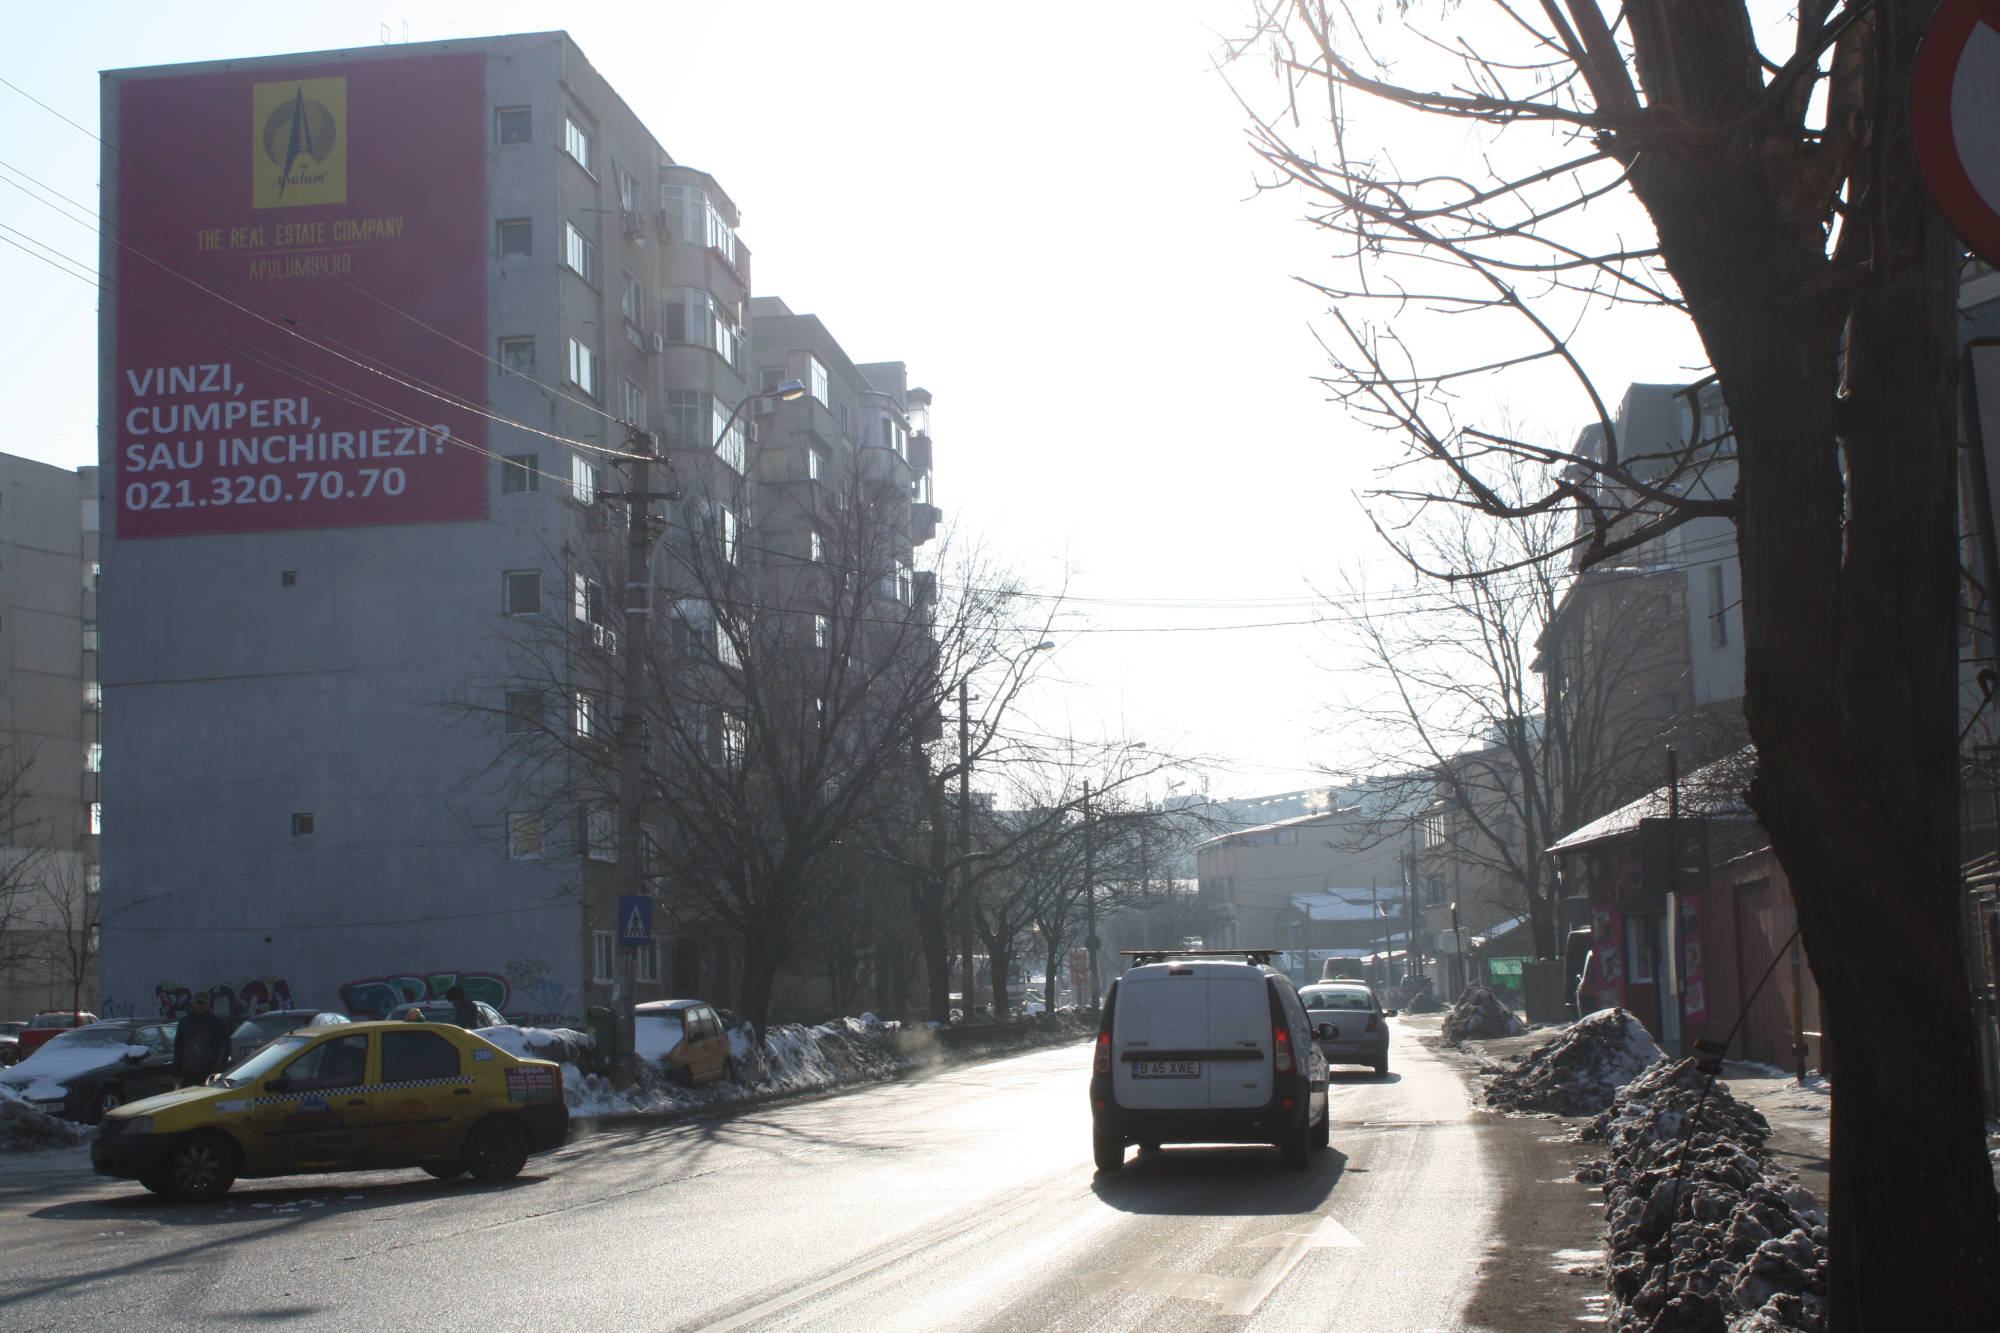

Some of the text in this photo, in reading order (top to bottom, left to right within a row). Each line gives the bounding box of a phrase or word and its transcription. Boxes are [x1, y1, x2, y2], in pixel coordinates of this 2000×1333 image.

[197, 216, 404, 251] THE REAL ESTATE COMPANY
[126, 363, 245, 397] VINZI,
[125, 397, 322, 435] CUMPERI,
[125, 424, 450, 473] SAU INCHIRIEZI?
[125, 467, 406, 511] 021.320.70.70
[1139, 1062, 1196, 1074] B 45 XWE
